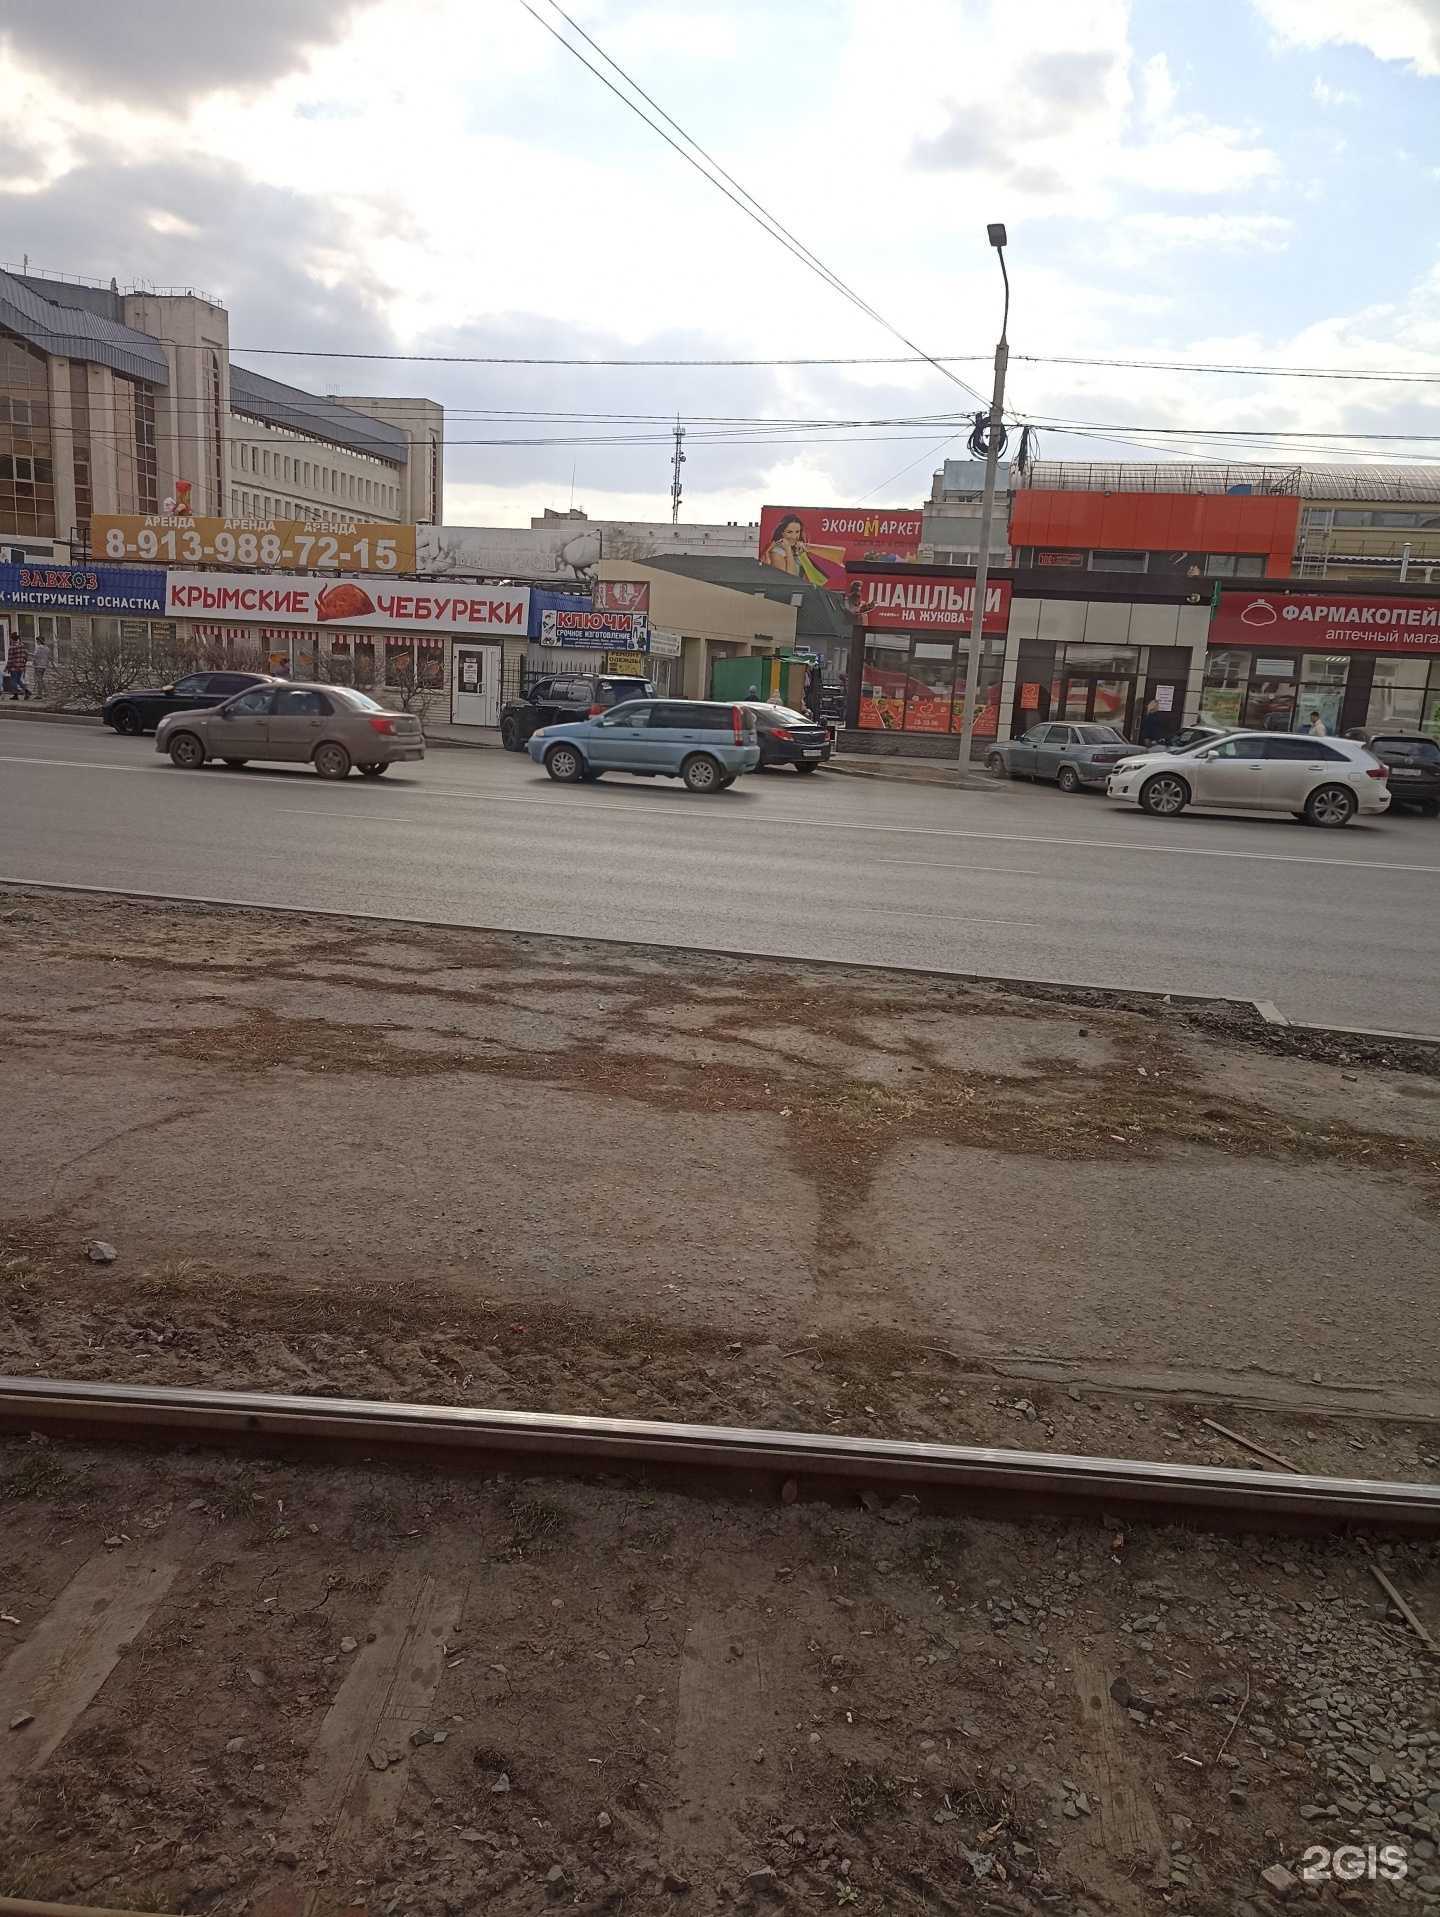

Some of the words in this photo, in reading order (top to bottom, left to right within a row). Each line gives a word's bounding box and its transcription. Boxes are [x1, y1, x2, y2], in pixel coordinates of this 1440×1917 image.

[145, 516, 196, 528] АРЕНДА
[224, 519, 276, 532] АРЕНДА
[303, 522, 357, 535] АРЕНДА
[821, 515, 921, 537] ЭКОНОМАРКЕТ
[106, 528, 398, 571] 8-913-988-72-15
[19, 569, 98, 590] ЗАВХОЗ
[12, 592, 90, 606] ИНСТРУМЕНТ
[97, 596, 160, 610] ОСНАСТКА
[171, 584, 310, 613] КРЫМСКИЕ
[376, 594, 524, 625] ЧЕБУРЕКИ
[557, 611, 633, 631] КЛЮЧИ
[902, 610, 916, 621] НА
[919, 611, 965, 623] ЖУКОВА
[1282, 605, 1440, 627] ФАРМАКОПЕЙ
[556, 629, 583, 638] СРОЧНОЕ
[584, 629, 631, 640] ИЗГОТОВЛЕНИЕ
[1326, 629, 1399, 643] аптечный
[1403, 632, 1440, 645] мага
